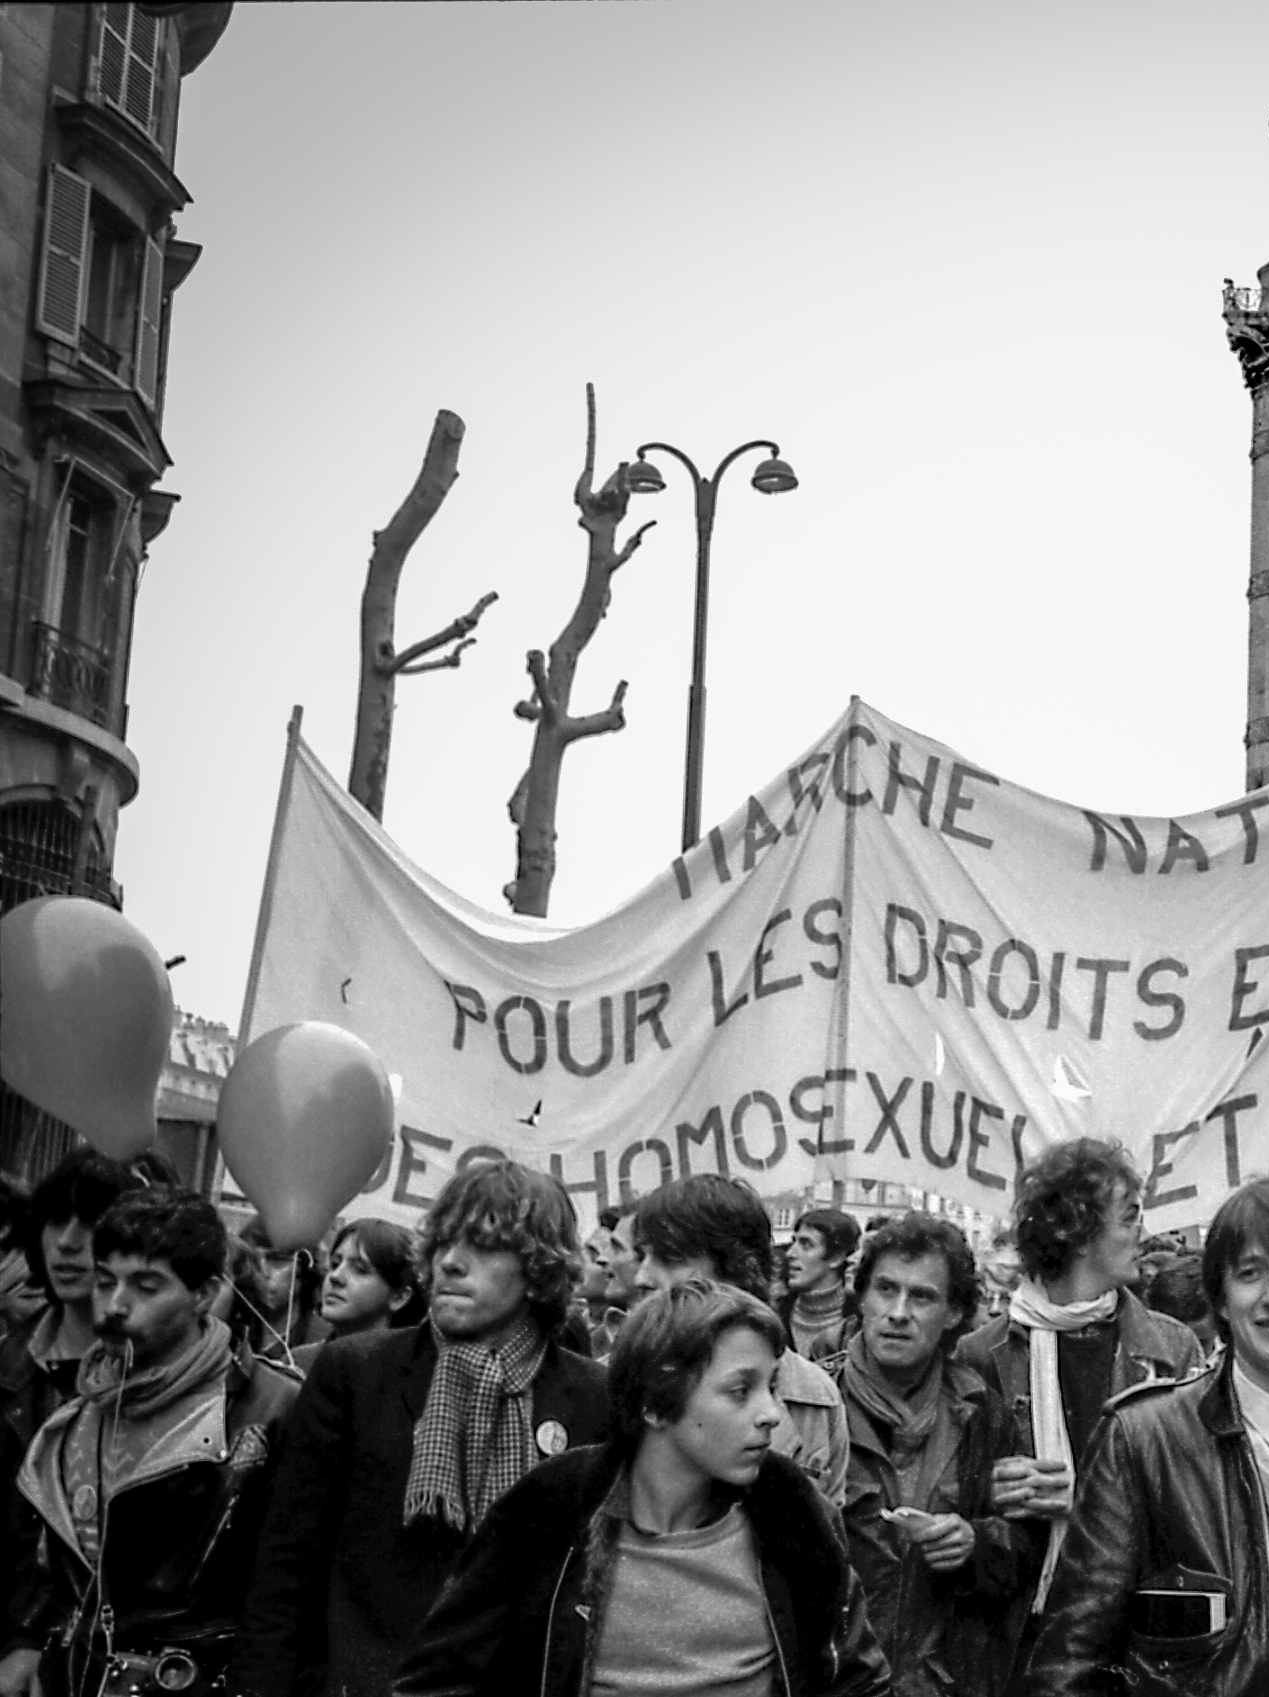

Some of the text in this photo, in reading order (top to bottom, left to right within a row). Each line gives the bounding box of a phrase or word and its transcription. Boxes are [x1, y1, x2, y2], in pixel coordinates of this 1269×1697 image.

[444, 980, 672, 1077] POUR
[707, 899, 843, 1027] LES
[885, 903, 1188, 1041] DROITS
[1143, 1094, 1257, 1209] ET
